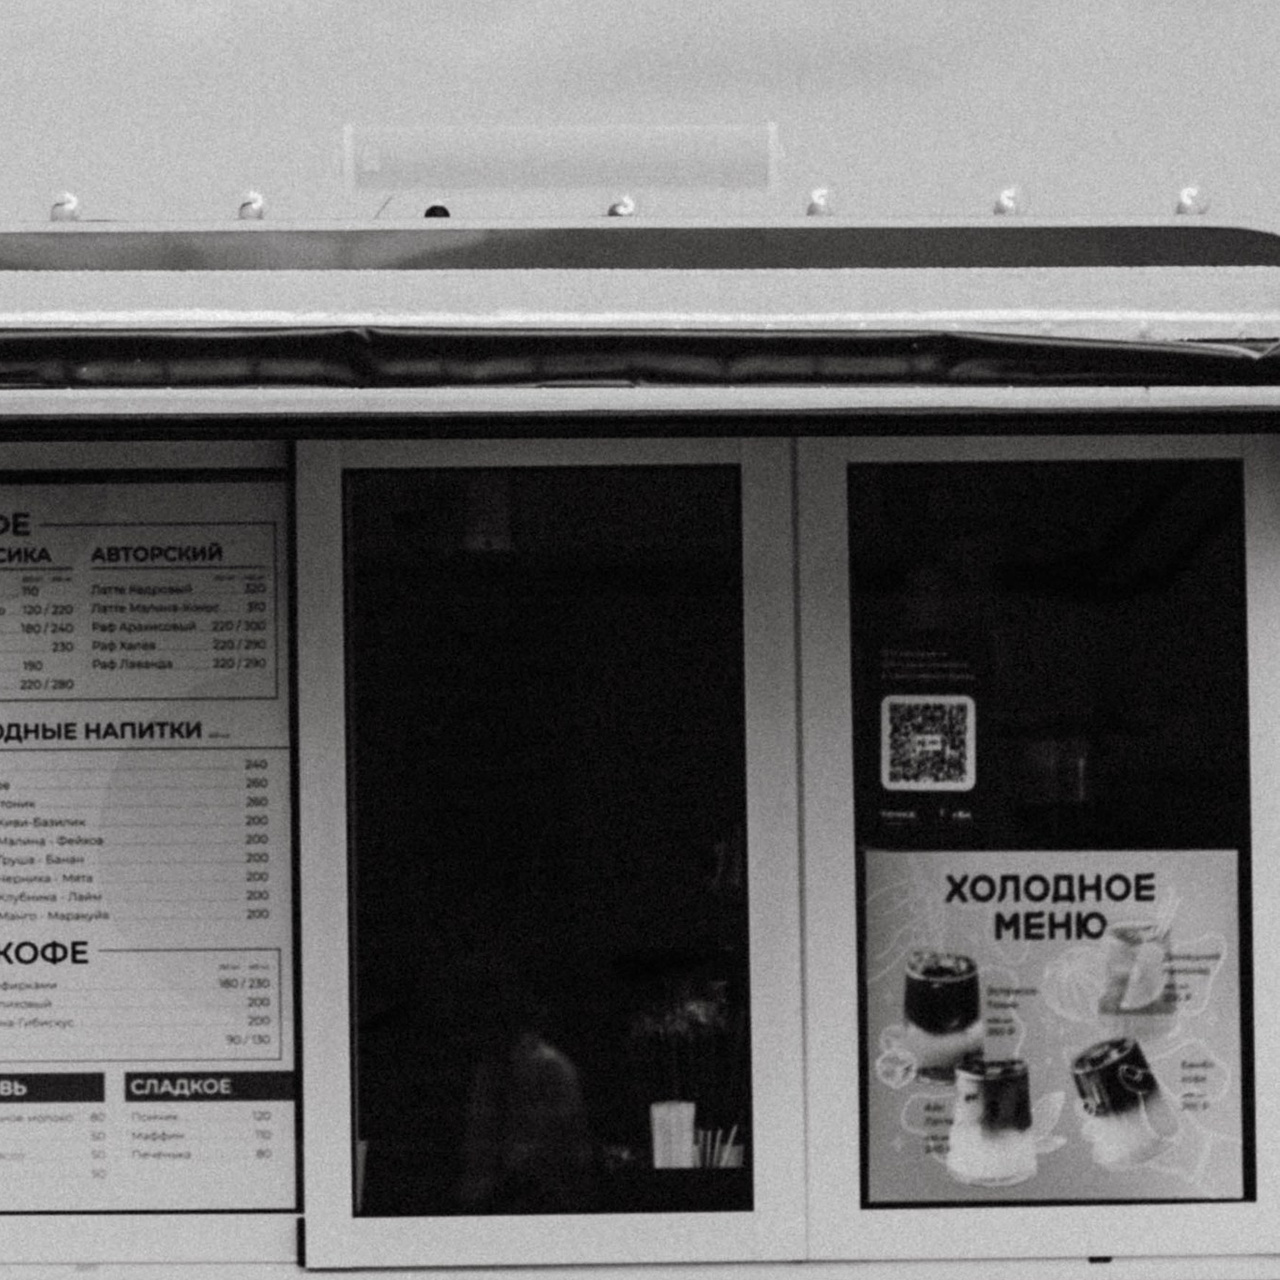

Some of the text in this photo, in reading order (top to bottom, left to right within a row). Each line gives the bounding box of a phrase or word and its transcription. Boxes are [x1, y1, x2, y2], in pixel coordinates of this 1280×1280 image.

[91, 542, 223, 562] АВТОРСКИЙ
[91, 584, 126, 594] Латте
[52, 604, 74, 614] 220
[91, 603, 126, 614] Латте
[92, 622, 117, 633] Раф
[92, 640, 117, 652] Раф
[92, 658, 117, 670] Раф
[85, 721, 202, 740] НАПИТКИ
[245, 759, 268, 770] 240
[246, 815, 269, 825] 200
[246, 833, 269, 844] 200
[46, 854, 85, 864] Банан
[246, 852, 269, 863] 200
[62, 872, 93, 883] Мята
[246, 871, 269, 882] 200
[946, 874, 1156, 902] ХОЛОДНОЕ
[68, 891, 102, 901] Лайм
[246, 890, 269, 900] 200
[48, 909, 109, 922] Маракуйя
[247, 908, 269, 919] 200
[995, 911, 1108, 940] МЕНЮ
[248, 996, 270, 1007] 200
[248, 1015, 271, 1026] 200
[131, 1078, 232, 1096] СЛАДКОЕ
[131, 1130, 185, 1142] Маффин
